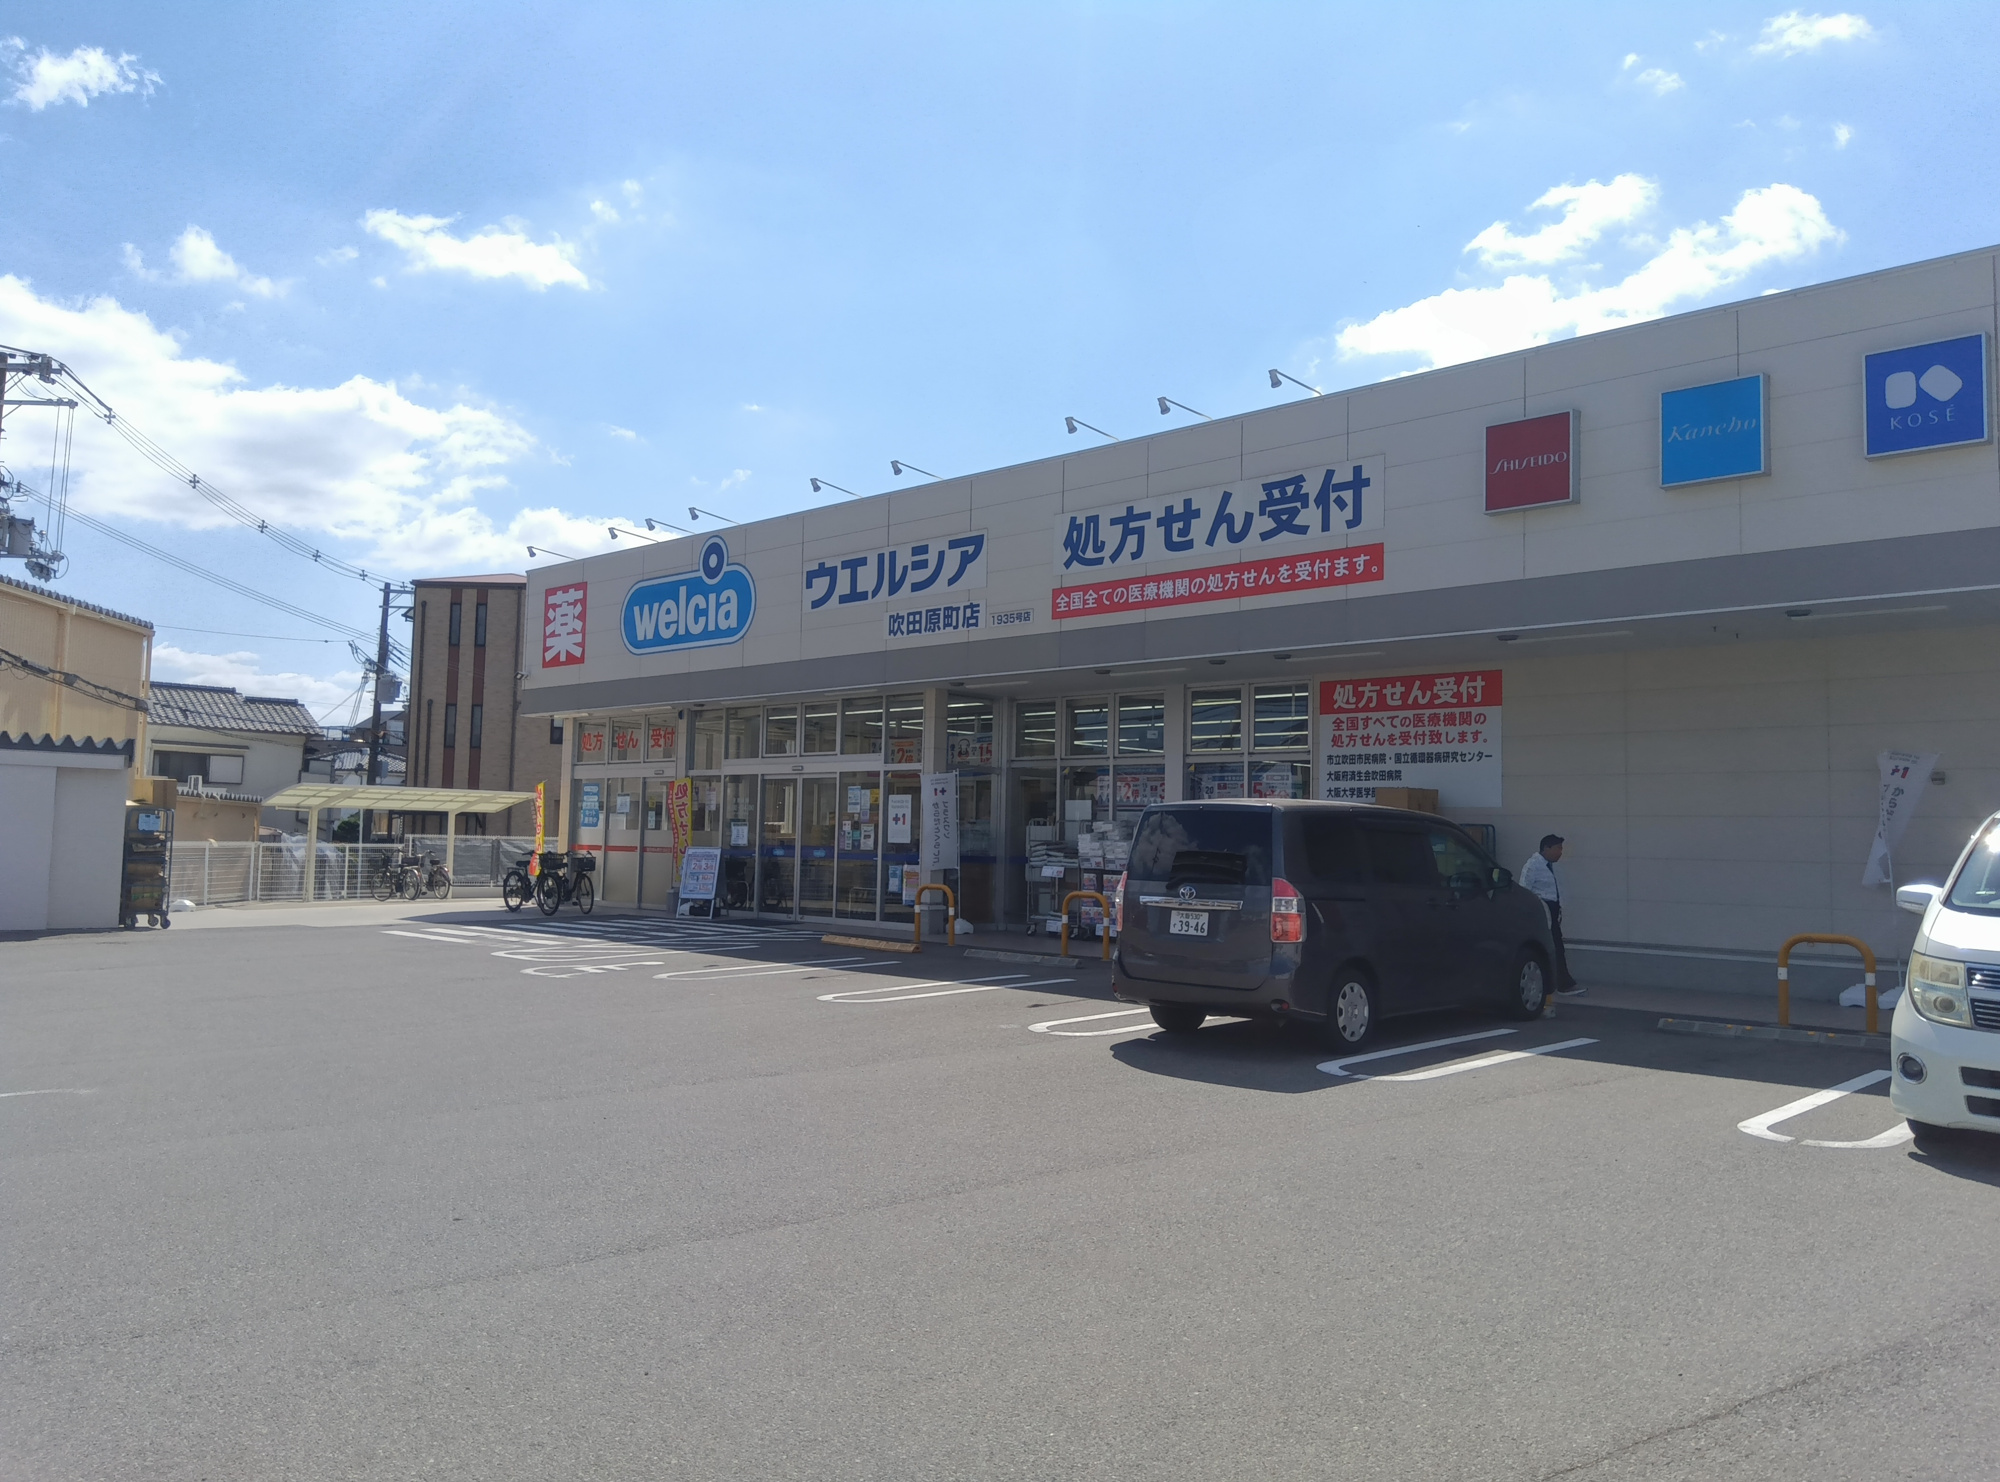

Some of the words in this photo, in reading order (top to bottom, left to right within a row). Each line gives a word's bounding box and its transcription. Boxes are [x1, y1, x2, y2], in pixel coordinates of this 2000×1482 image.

[1667, 416, 1759, 445] Kanebo
[1889, 404, 1957, 430] KOSÉ
[1488, 450, 1568, 475] SHISEIDO
[1063, 464, 1371, 570] 処方せん受付
[805, 533, 986, 610] ウエルシア
[1055, 554, 1379, 612] 全国全ての医療機関の処方せんを受付ます。
[544, 587, 583, 663] 薬
[633, 588, 738, 641] welcia
[888, 601, 981, 638] 吹田原町店
[991, 611, 1031, 625] 1935号店
[1333, 675, 1486, 709] 処方せん受付
[1332, 711, 1487, 732] 全国すべての医療機関の
[581, 732, 604, 752] 処方
[616, 730, 639, 750] せん
[650, 727, 676, 749] 受付
[1331, 729, 1488, 748] 処方せんを受付致します。
[1178, 920, 1206, 934] 39-46
